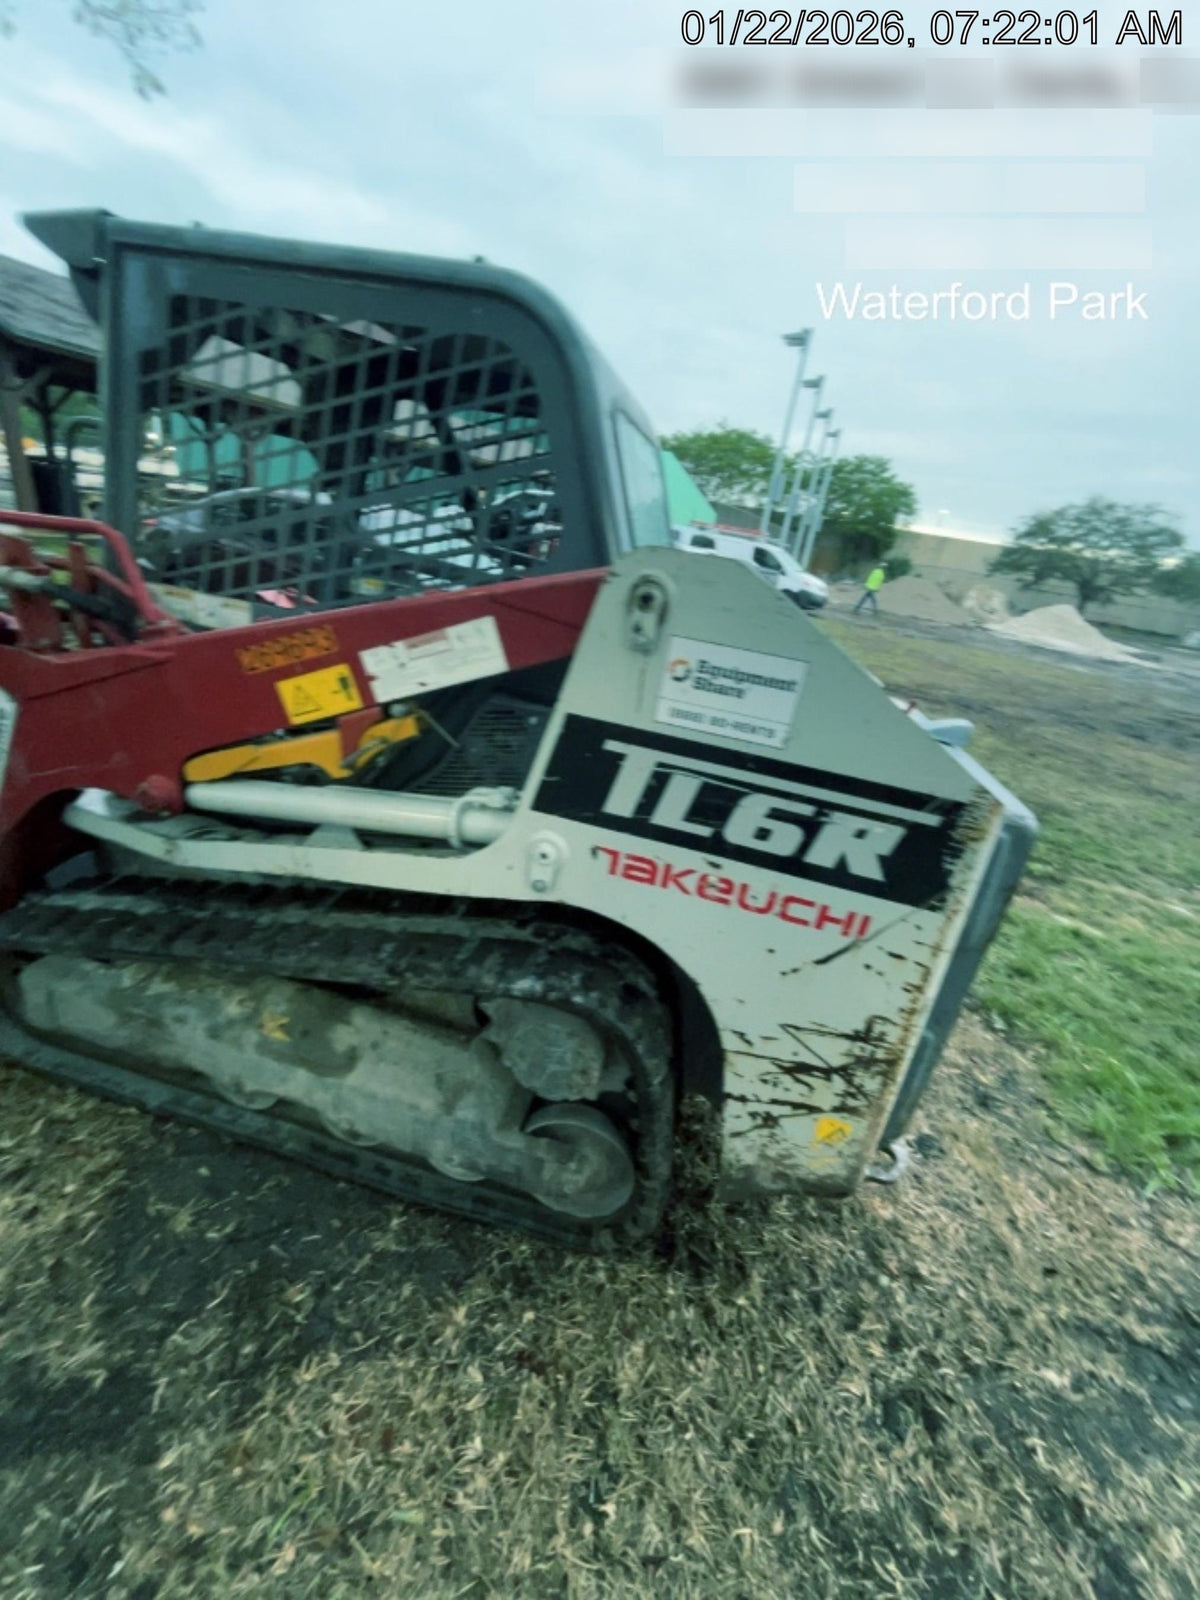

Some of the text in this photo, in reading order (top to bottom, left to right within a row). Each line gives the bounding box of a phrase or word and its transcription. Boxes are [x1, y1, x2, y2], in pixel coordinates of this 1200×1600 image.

[692, 676, 745, 699] Share
[696, 658, 798, 693] Equipment
[602, 738, 944, 882] TL6R
